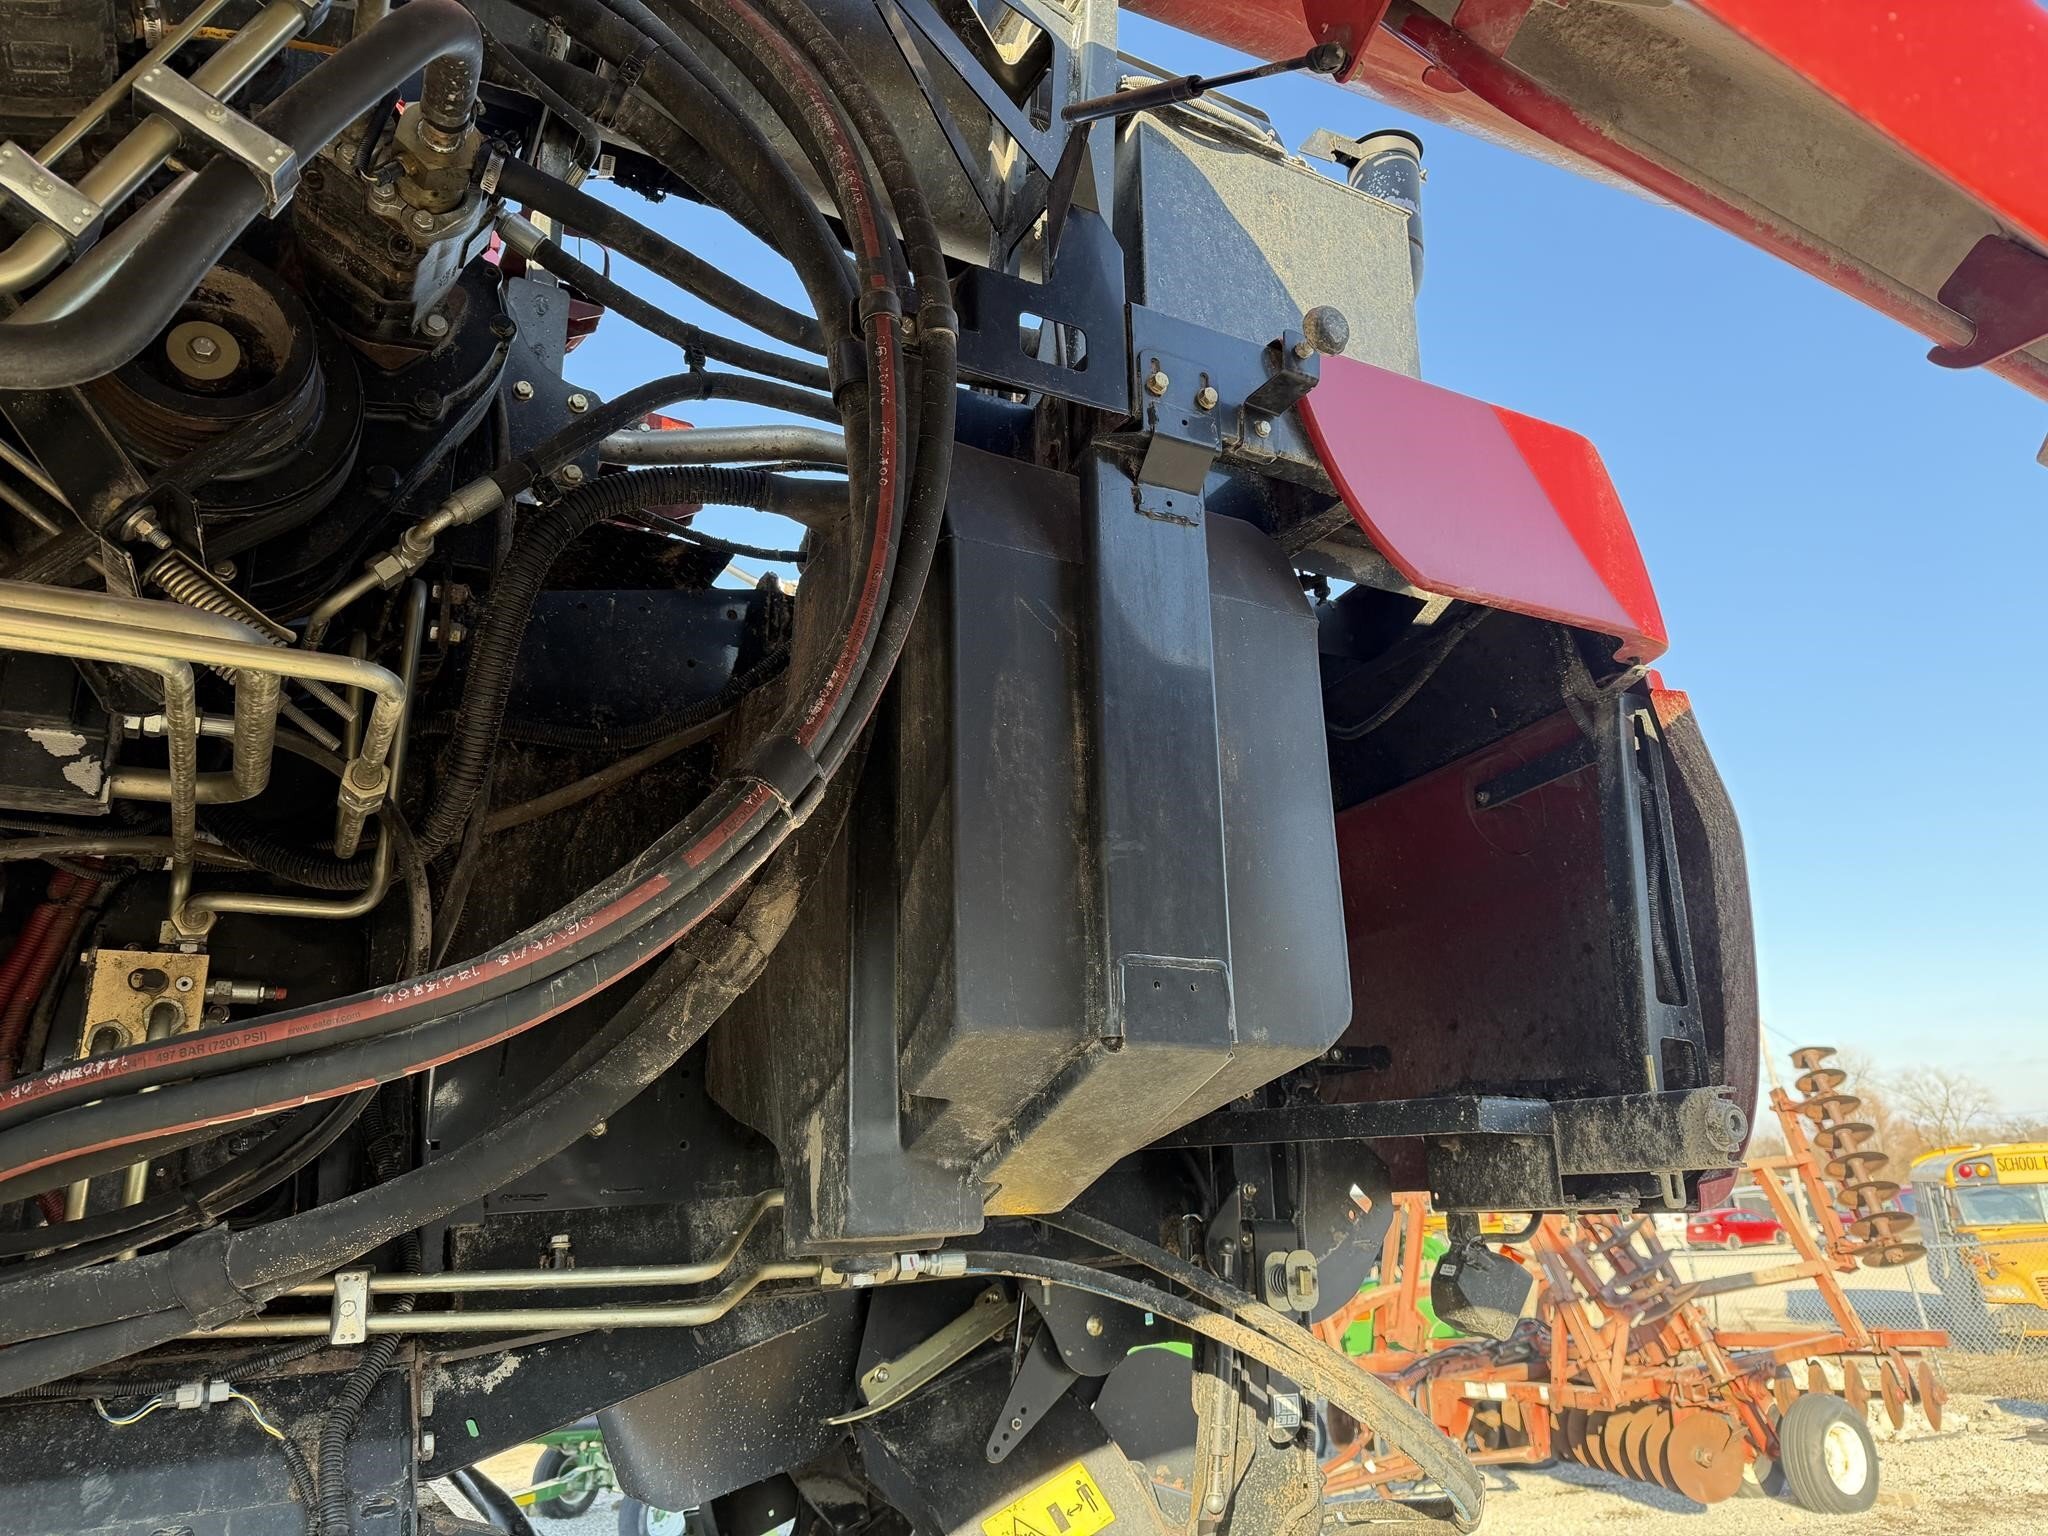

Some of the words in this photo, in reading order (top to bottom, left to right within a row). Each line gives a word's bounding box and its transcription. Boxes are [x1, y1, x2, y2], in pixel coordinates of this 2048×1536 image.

[155, 1049, 175, 1063] 497
[178, 1043, 206, 1059] BAR
[207, 1036, 240, 1054] (7200
[242, 1029, 268, 1045] PSI)
[1997, 1156, 2039, 1172] SCHOOL
